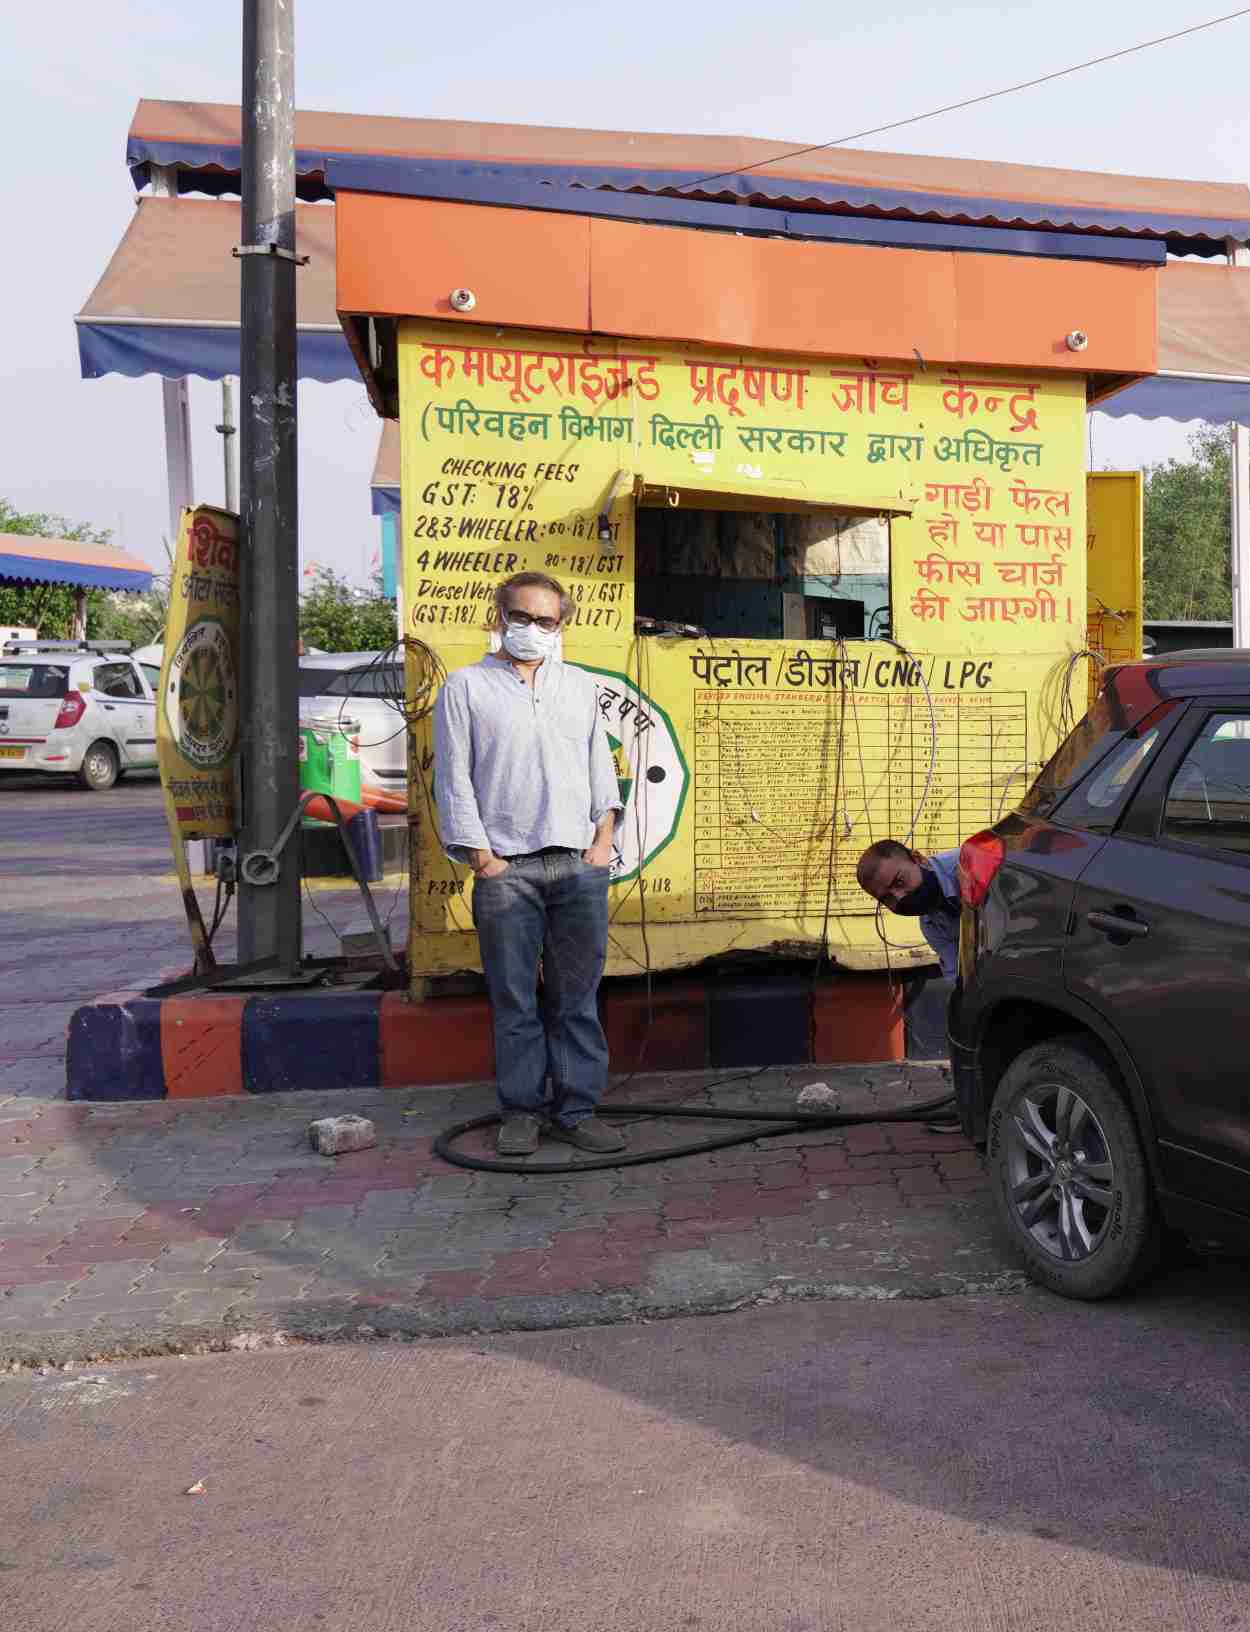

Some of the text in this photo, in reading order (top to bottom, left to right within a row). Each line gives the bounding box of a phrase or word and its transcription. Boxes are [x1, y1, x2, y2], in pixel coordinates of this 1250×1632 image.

[684, 359, 810, 417] प्रदूषण
[941, 368, 1041, 432] केन्द्र
[648, 412, 724, 450] दिल्ली
[736, 425, 849, 458] सरकार
[867, 432, 925, 464] द्वारा
[934, 428, 1043, 472] अधिकृत
[441, 458, 580, 482] CHECKING FEES
[496, 483, 535, 511] 18%
[1008, 478, 1072, 517] फेल
[925, 512, 960, 551] हो
[973, 521, 1007, 548] या
[1016, 523, 1072, 552] पास
[417, 549, 429, 573] 4
[596, 554, 624, 573] GST
[913, 552, 1067, 587] फीस चार्ज
[598, 582, 625, 603] GST
[910, 587, 951, 622] की
[943, 660, 993, 689] LPG
